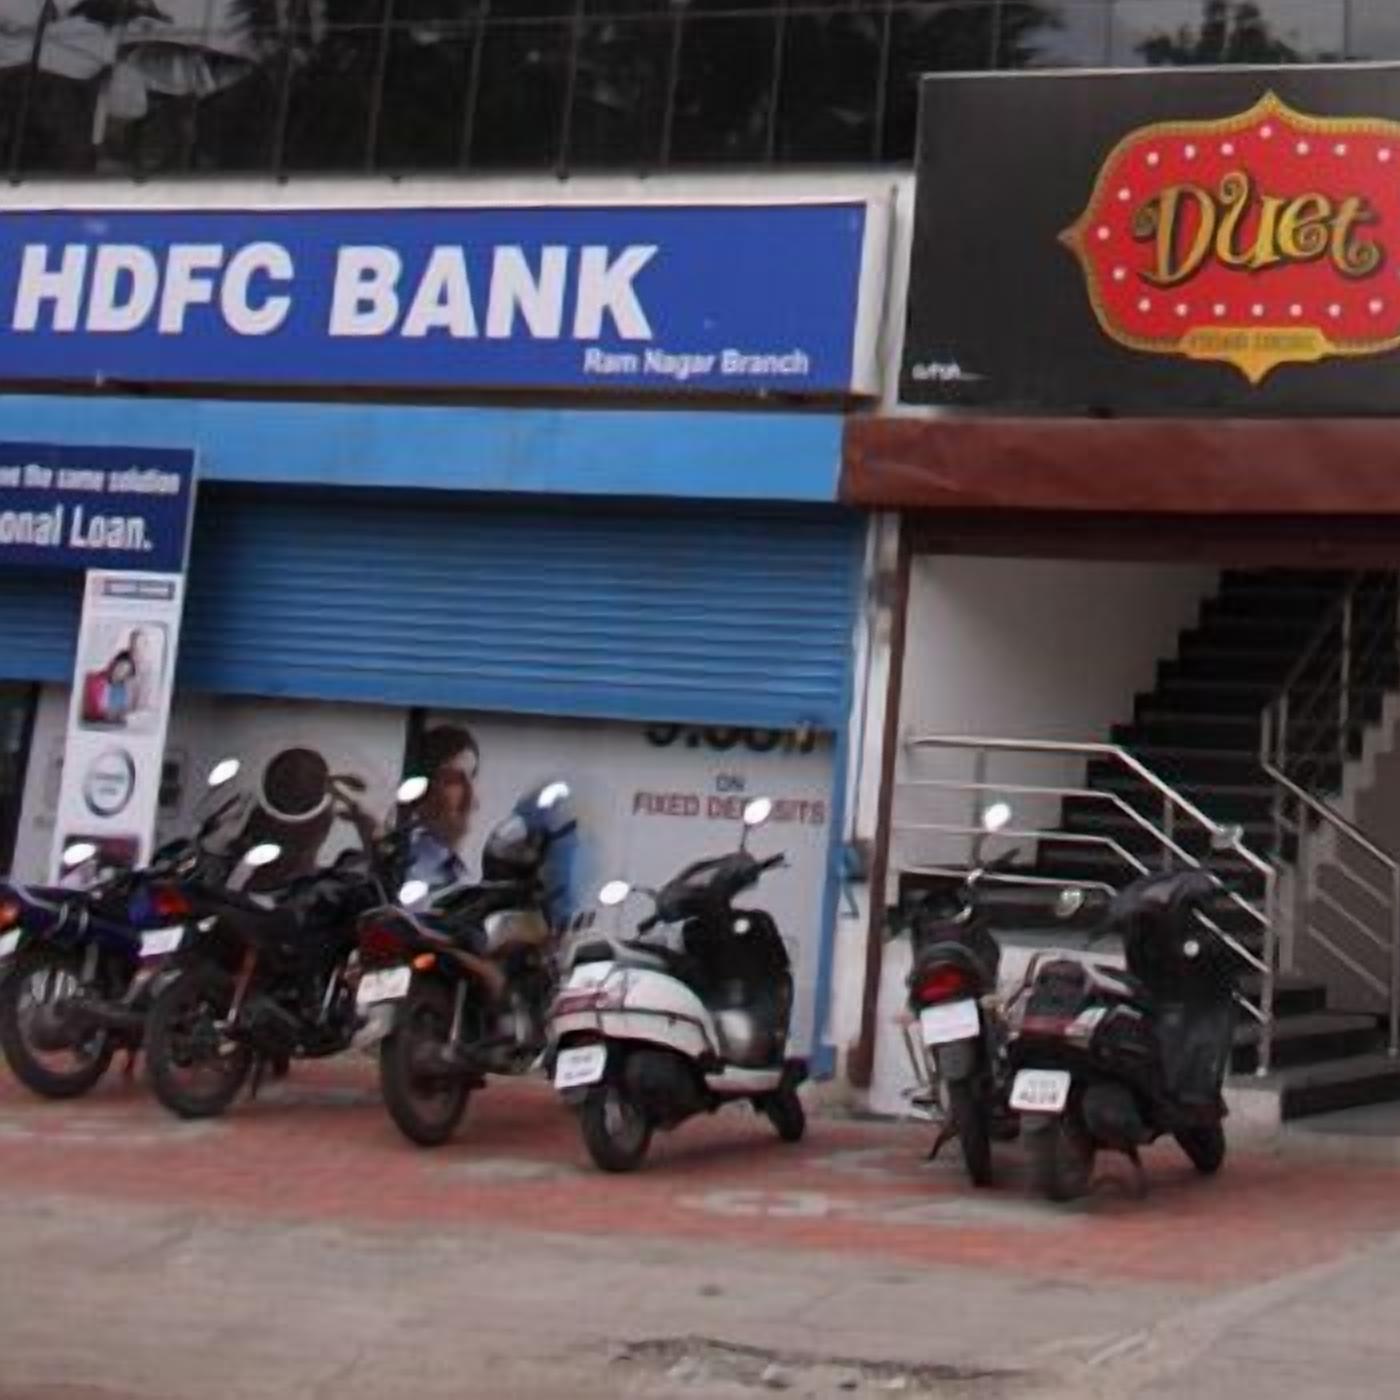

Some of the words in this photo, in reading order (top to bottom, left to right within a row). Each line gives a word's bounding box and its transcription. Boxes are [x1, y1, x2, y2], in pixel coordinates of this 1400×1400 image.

[1131, 170, 1382, 284] Duet
[12, 241, 294, 335] HDFC
[328, 244, 658, 340] BANK
[583, 348, 638, 375] Ram
[643, 348, 715, 380] Nagar
[720, 348, 809, 375] Branch
[69, 503, 154, 552] Loan.
[632, 791, 700, 816] FIXED
